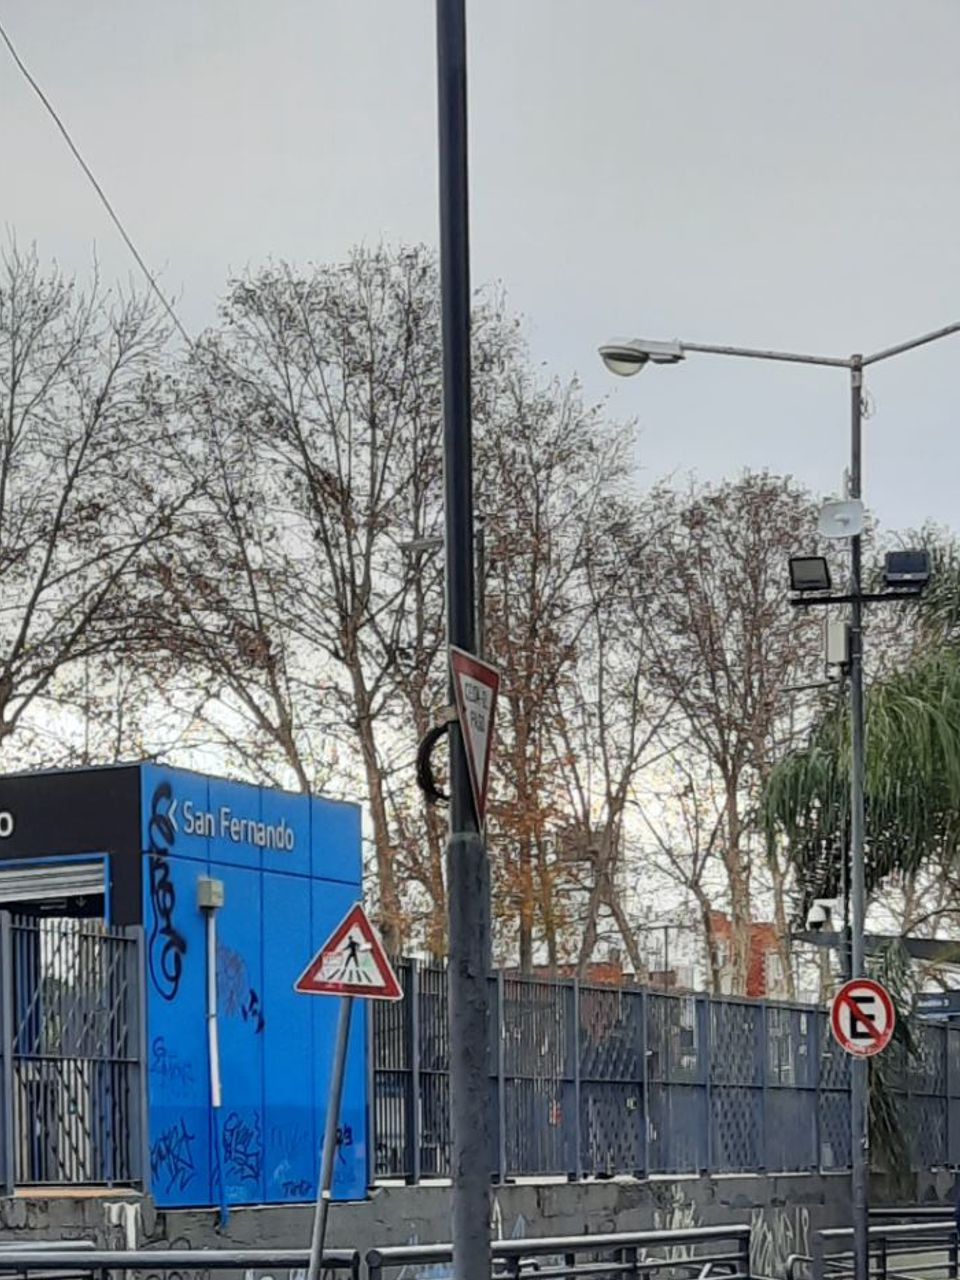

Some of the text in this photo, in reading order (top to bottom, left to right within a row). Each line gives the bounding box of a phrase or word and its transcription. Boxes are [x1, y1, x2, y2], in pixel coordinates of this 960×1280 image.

[183, 800, 295, 851] San Fernando
[849, 995, 876, 1039] E
